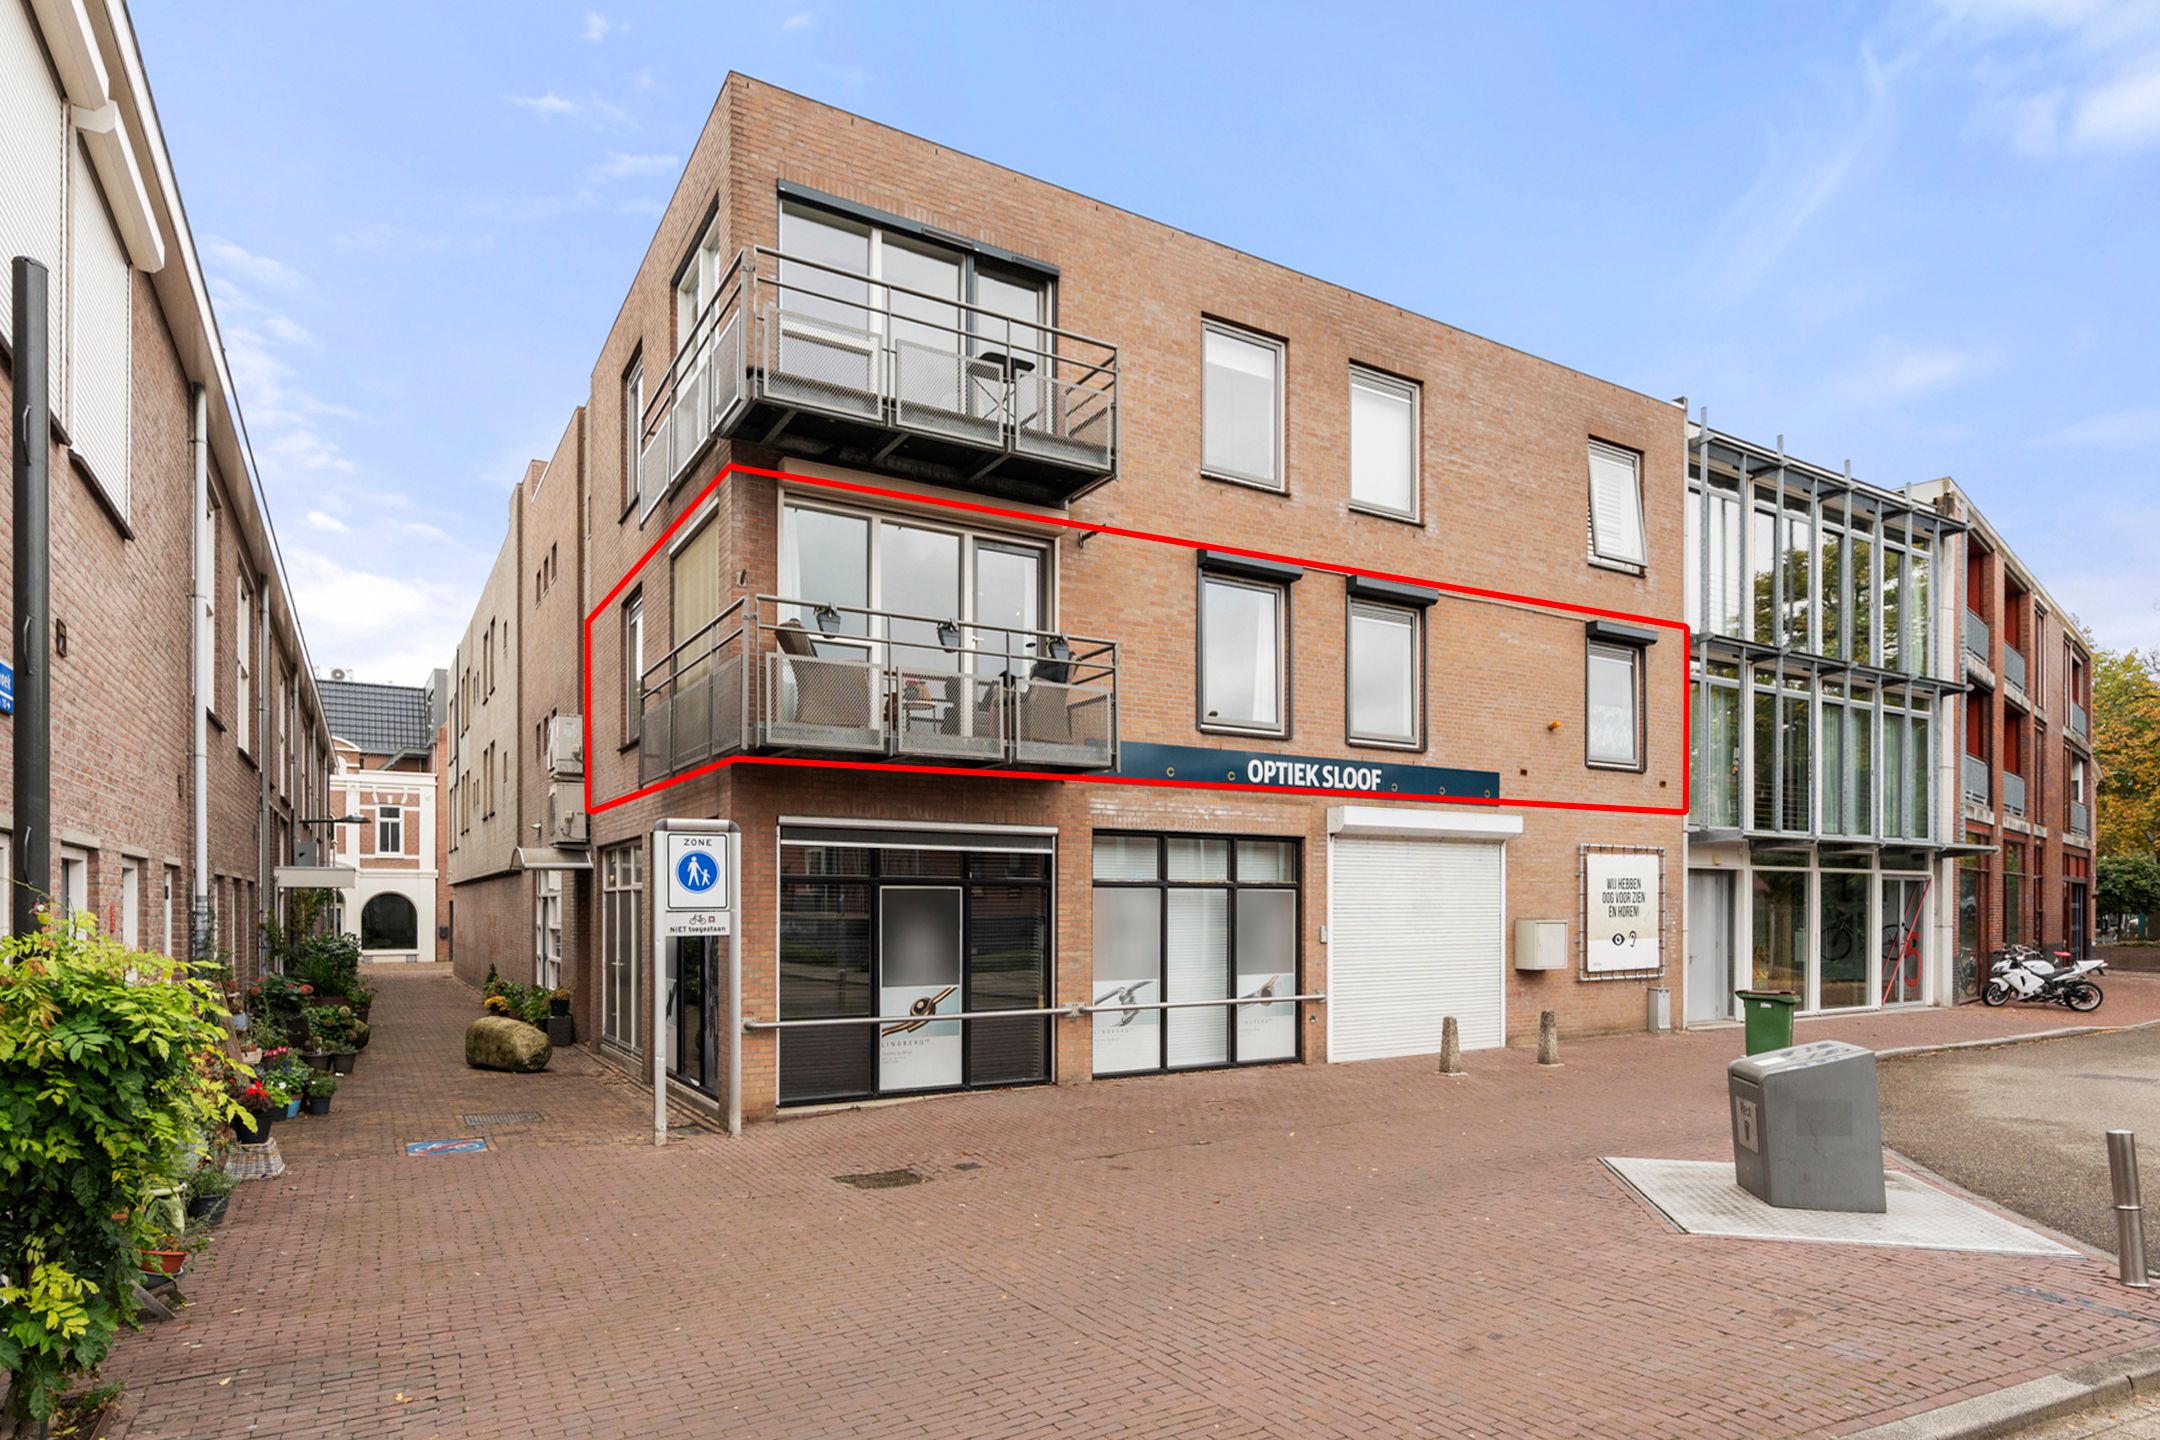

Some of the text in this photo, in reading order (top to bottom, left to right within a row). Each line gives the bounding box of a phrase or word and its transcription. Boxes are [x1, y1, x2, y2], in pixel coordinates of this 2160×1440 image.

[1247, 759, 1382, 791] OPTIEK SLOOF
[683, 838, 712, 847] ZONE
[1606, 878, 1642, 890] WIJ HEBBEN
[1601, 891, 1646, 904] OOG VOOR ZIEN
[688, 926, 726, 934] toegestaan
